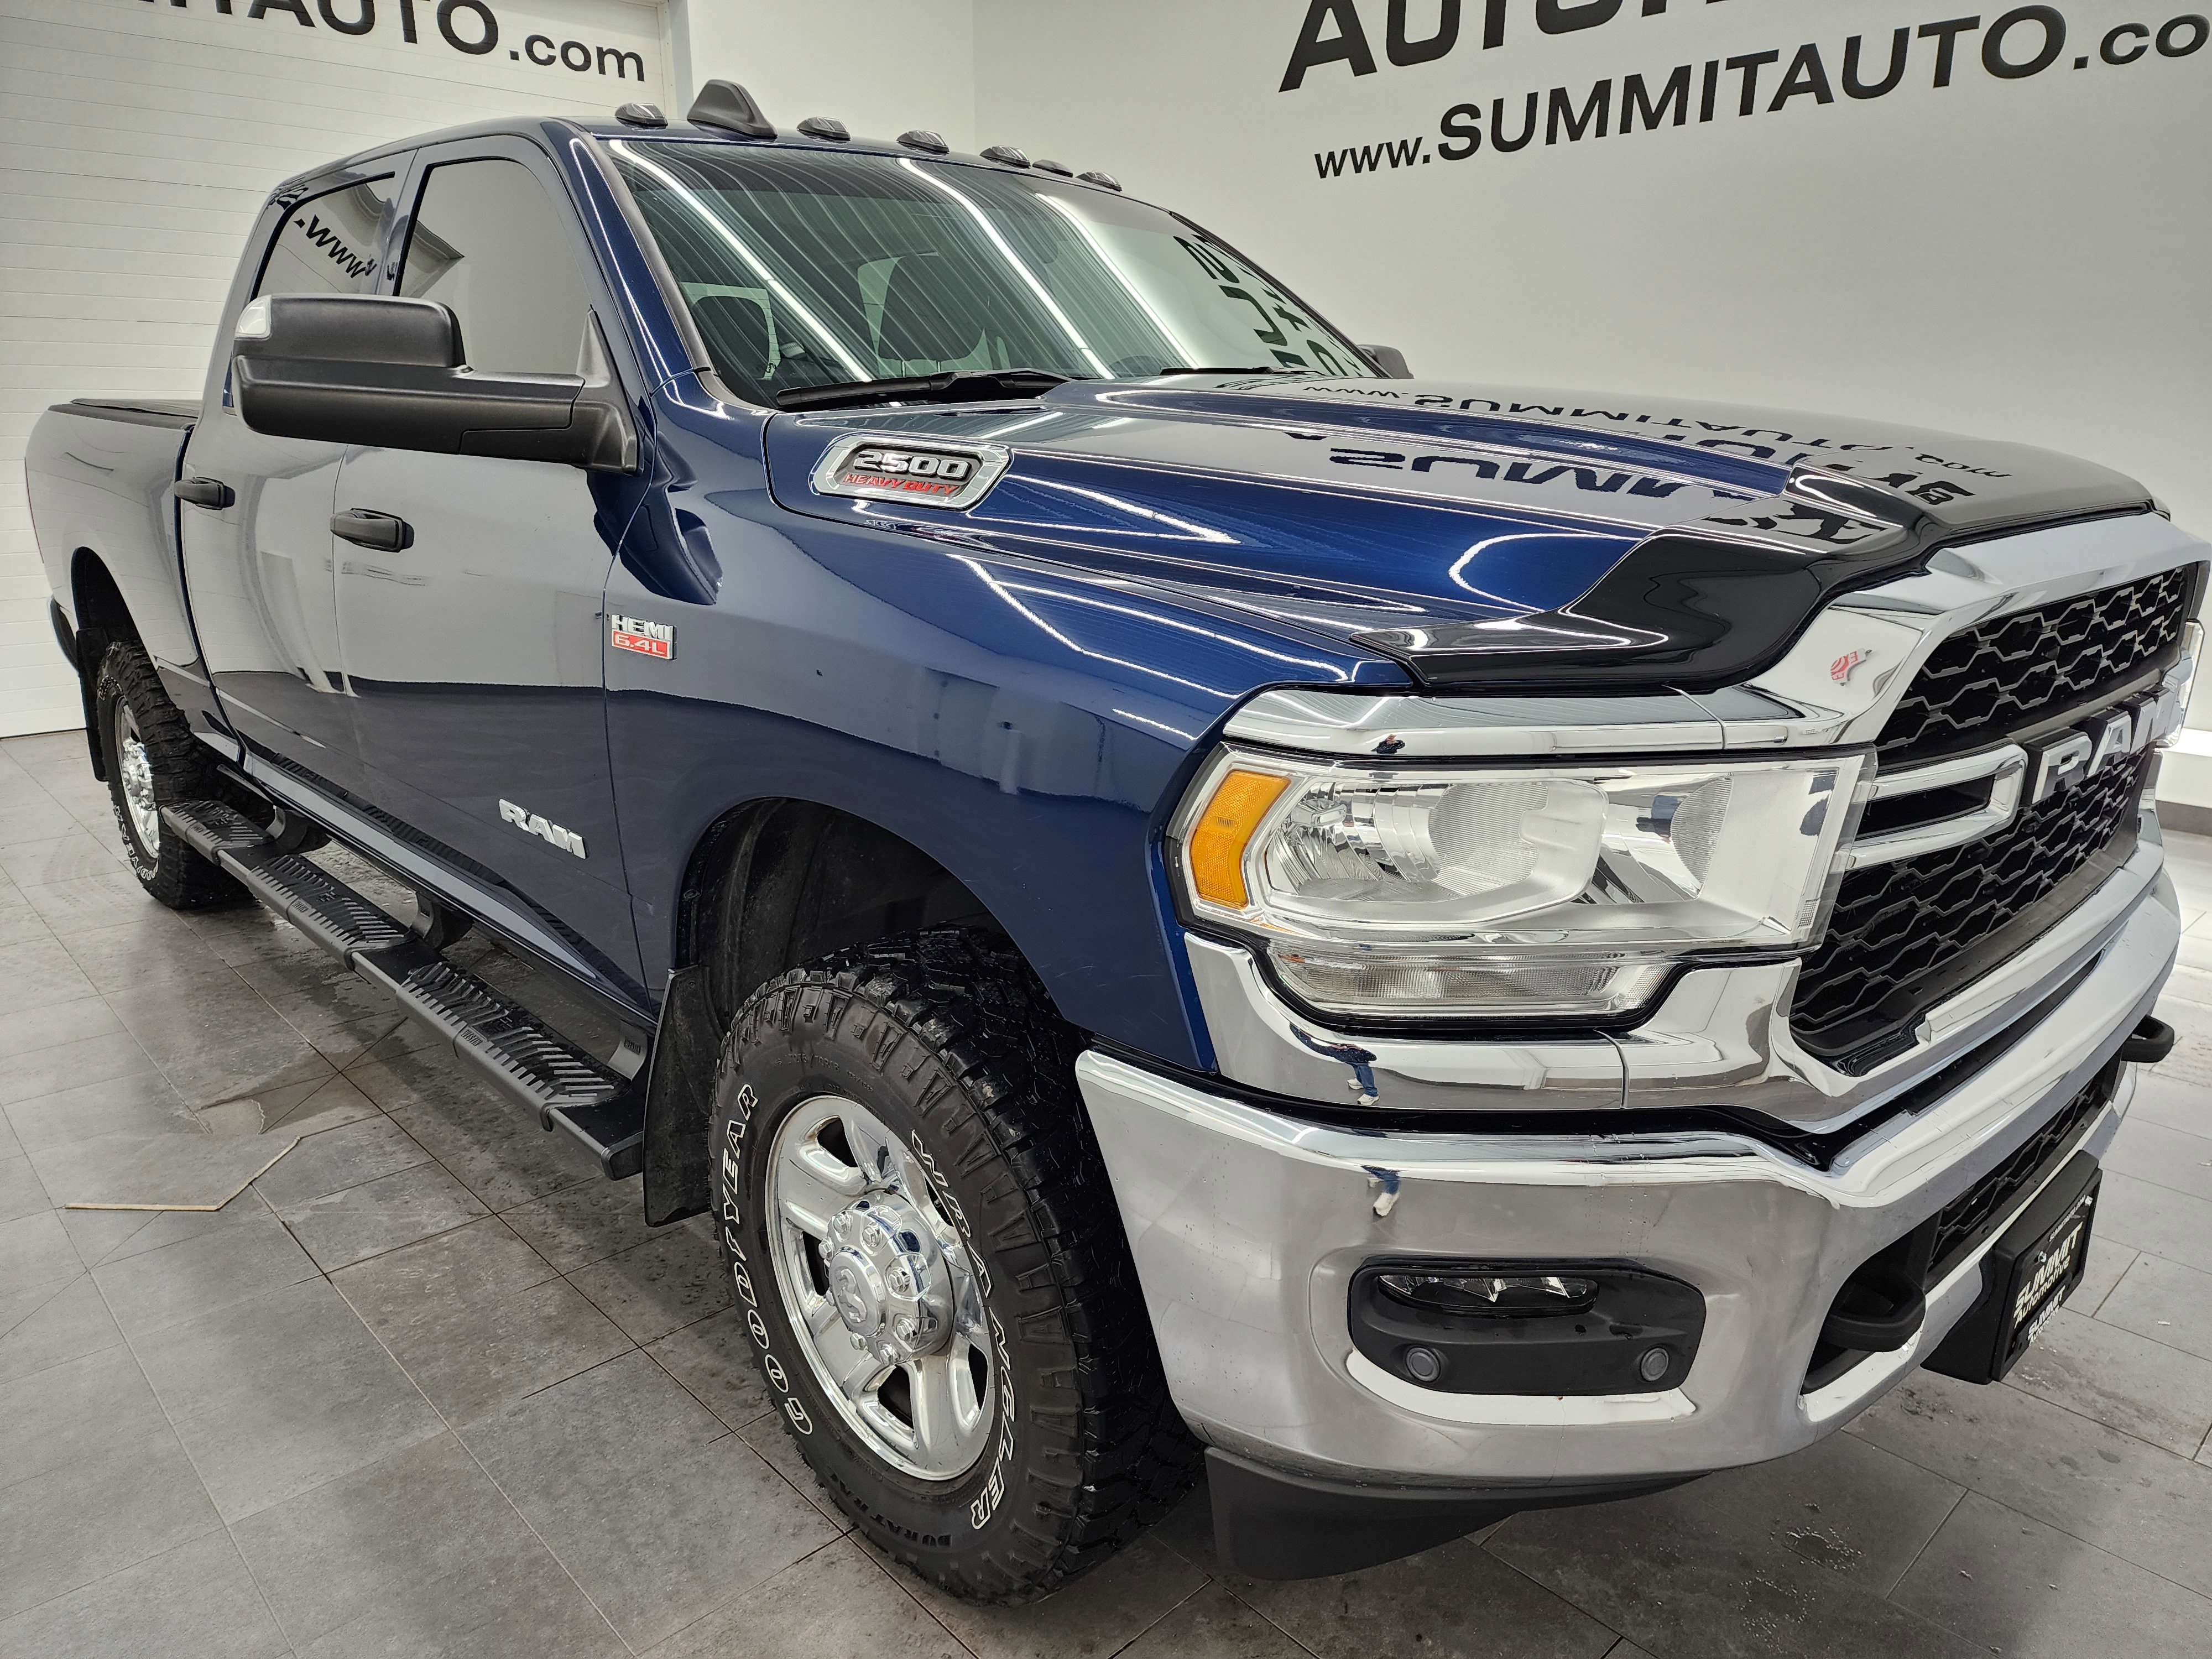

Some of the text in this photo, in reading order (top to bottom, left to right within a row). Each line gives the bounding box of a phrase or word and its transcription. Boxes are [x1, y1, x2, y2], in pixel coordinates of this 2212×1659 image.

[1314, 5, 2211, 179] www.SUMMITAUTO.co
[843, 473, 959, 494] HEAVY DUTY
[853, 451, 972, 480] 2500
[612, 614, 674, 643] HEMI
[614, 633, 666, 655] 6.4L
[2032, 689, 2175, 805] RAM
[499, 799, 587, 859] RAM
[722, 1083, 813, 1436] GOODYEAR
[2013, 1220, 2083, 1319] SUMMIT
[2014, 1255, 2070, 1329] Automotive
[911, 1128, 1015, 1530] WRANGLER
